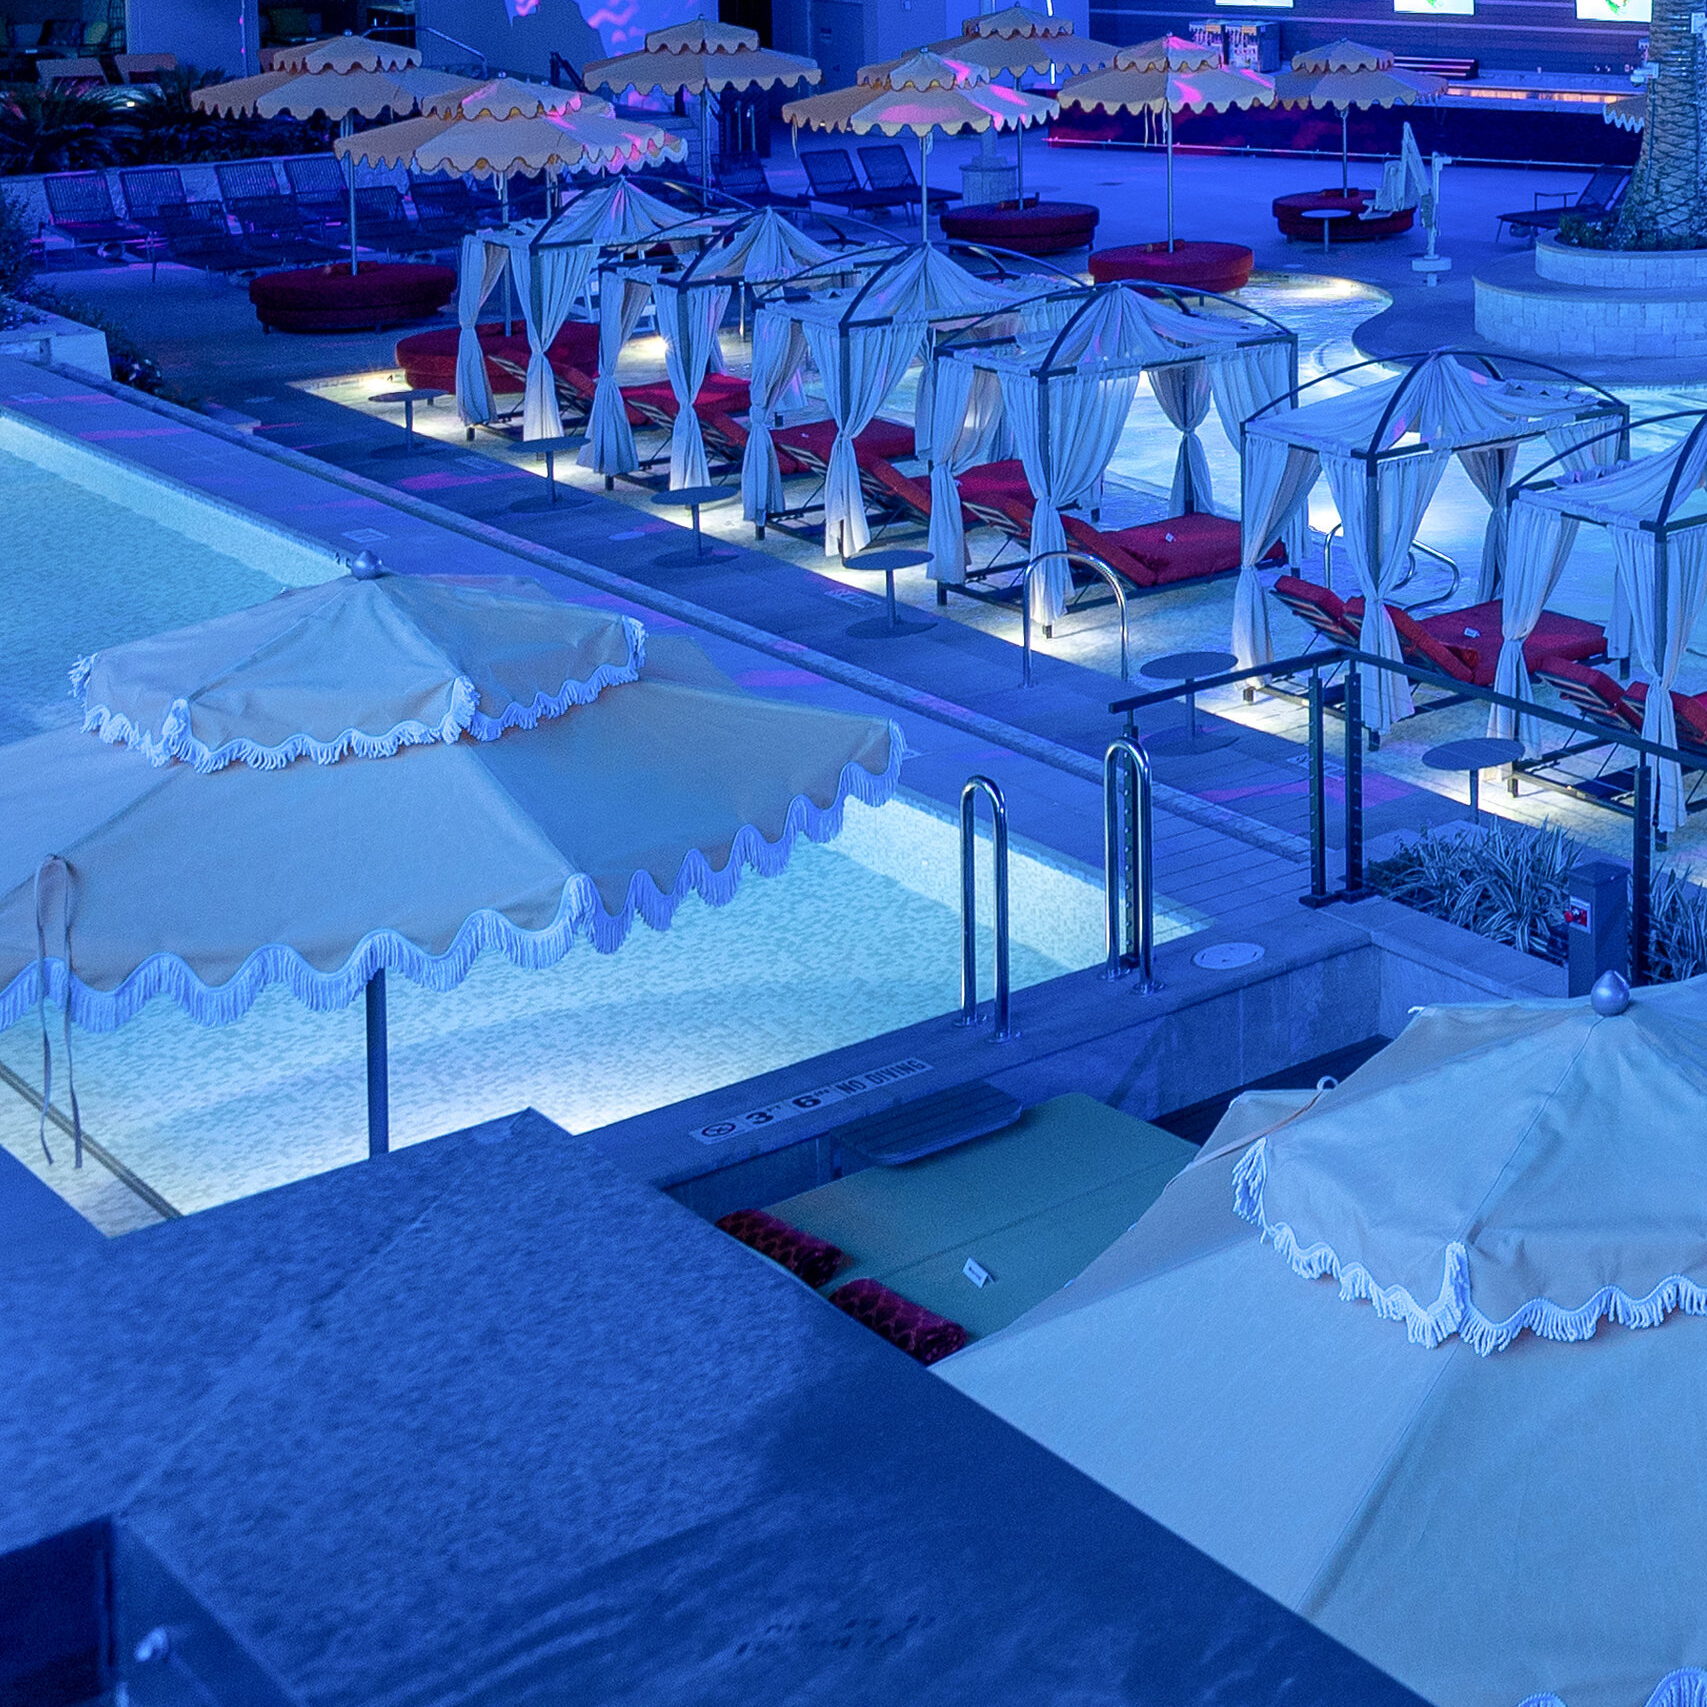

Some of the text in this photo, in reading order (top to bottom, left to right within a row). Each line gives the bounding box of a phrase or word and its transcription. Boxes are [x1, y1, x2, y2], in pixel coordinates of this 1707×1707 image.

[745, 1111, 774, 1125] 3
[792, 1095, 821, 1109] 6
[836, 1080, 867, 1095] NO
[865, 1060, 926, 1085] DIVING
